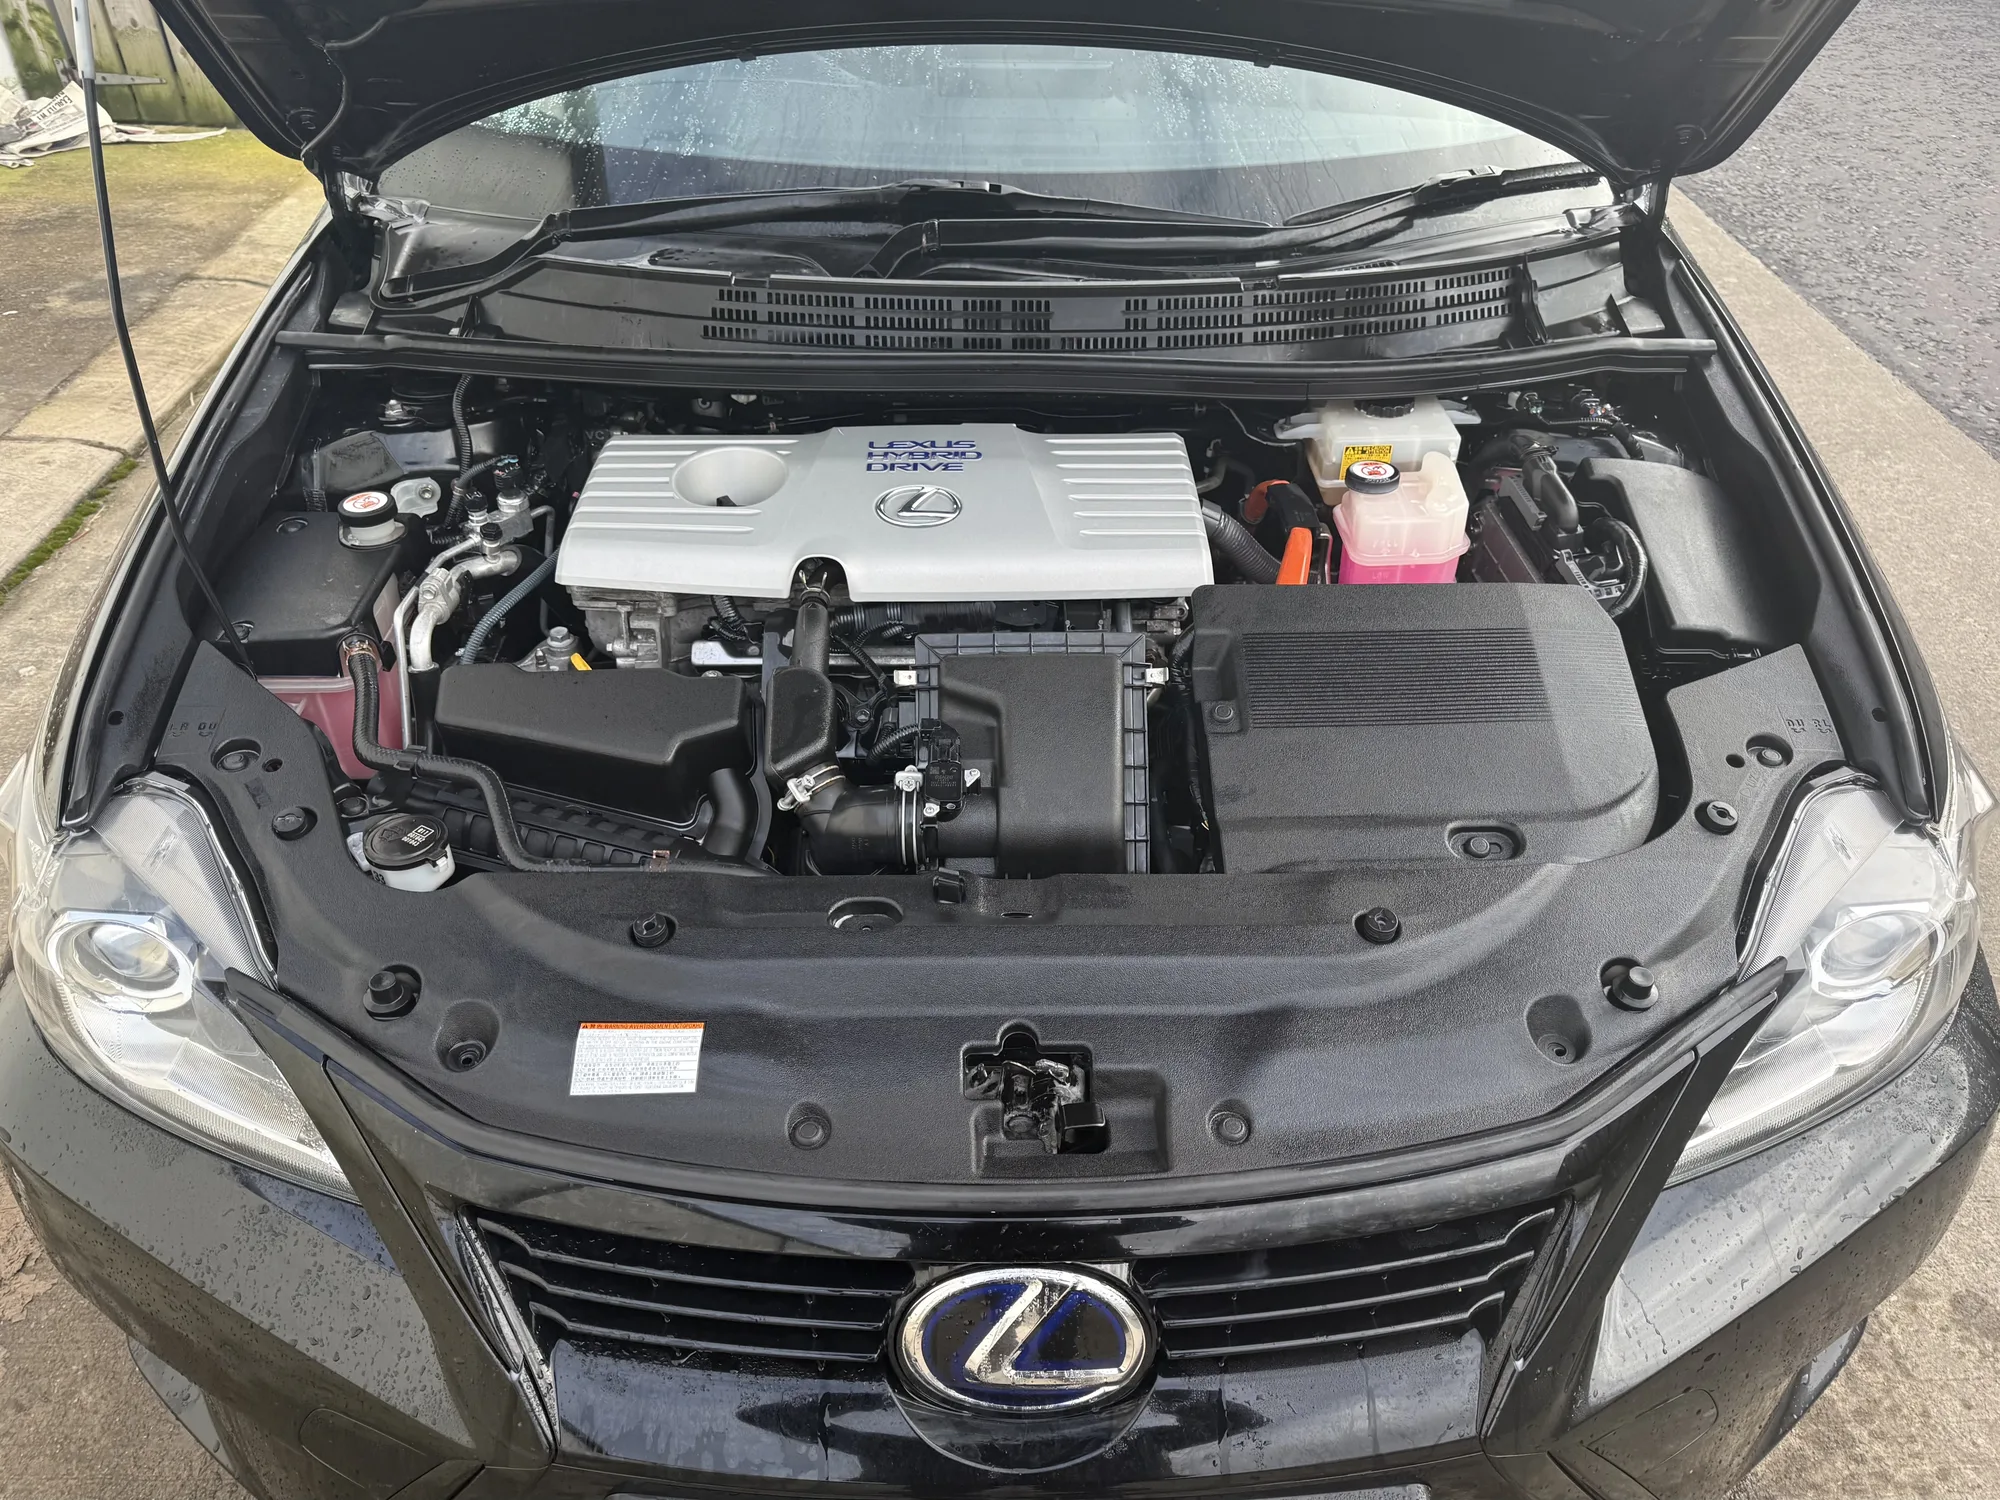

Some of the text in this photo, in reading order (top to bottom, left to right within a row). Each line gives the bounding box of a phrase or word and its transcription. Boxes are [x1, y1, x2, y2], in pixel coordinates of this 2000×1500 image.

[868, 440, 977, 450] LEXUS
[866, 451, 983, 461] HYBRID
[866, 462, 964, 472] DRIVE
